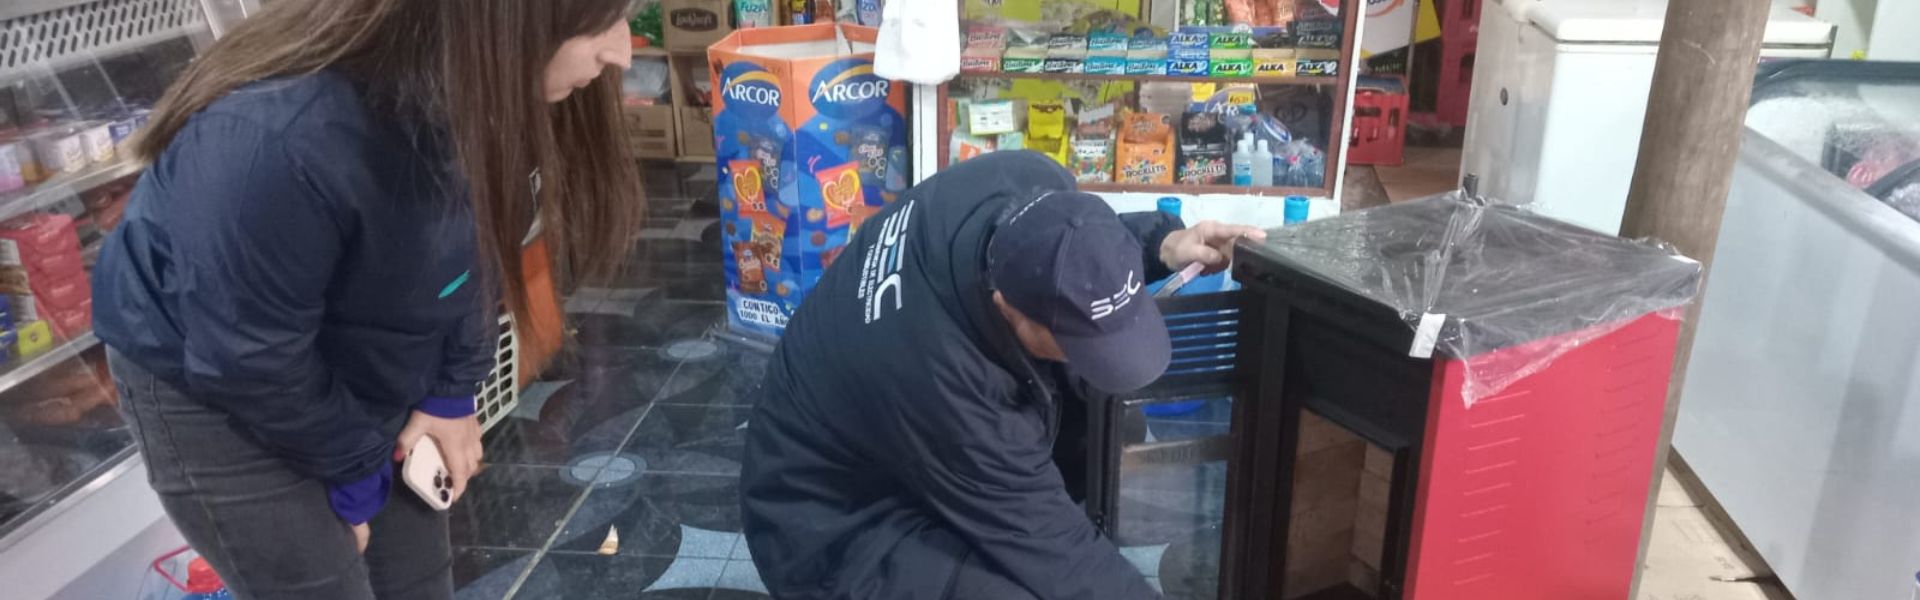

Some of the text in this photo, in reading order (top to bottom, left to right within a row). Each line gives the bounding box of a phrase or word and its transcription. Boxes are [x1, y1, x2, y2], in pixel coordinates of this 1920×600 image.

[1173, 35, 1198, 44] ALKA
[1216, 36, 1242, 45] ALKA
[1173, 63, 1198, 71] ALKA
[1216, 63, 1242, 72] ALKA
[1258, 63, 1285, 72] ALKA
[1301, 63, 1325, 71] ALKA
[722, 78, 780, 106] ARCOR
[812, 80, 888, 103] ARCOR
[1125, 164, 1166, 178] ROCKLETS
[1184, 162, 1227, 178] ROCKLETS
[874, 199, 915, 321] SEC
[1091, 270, 1141, 320] SEC
[743, 300, 779, 315] CONTIGO
[740, 309, 758, 320] TODO
[761, 314, 771, 323] EL
